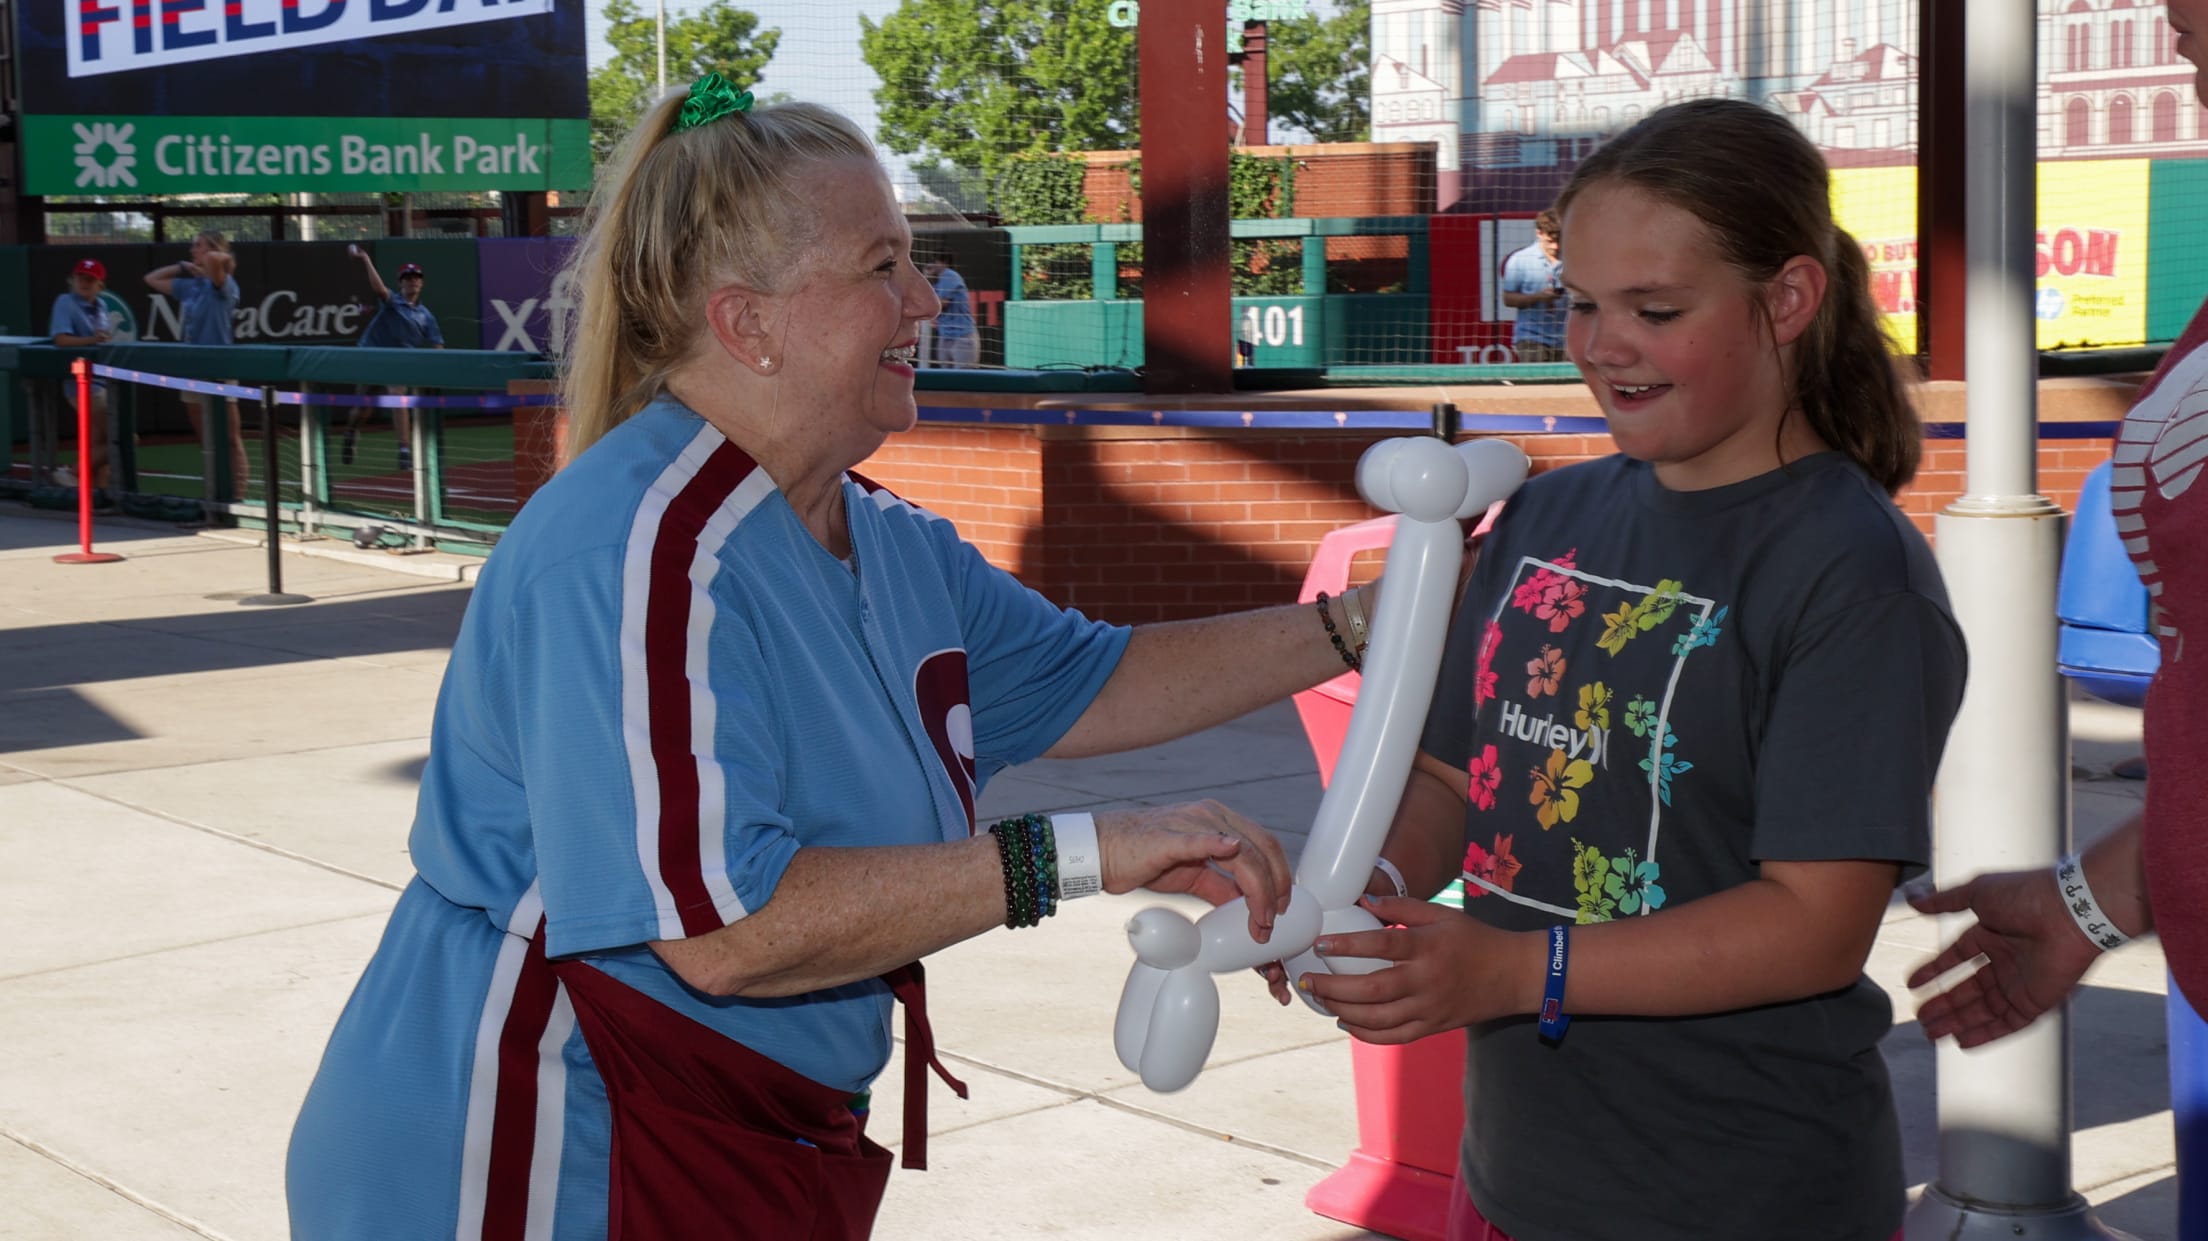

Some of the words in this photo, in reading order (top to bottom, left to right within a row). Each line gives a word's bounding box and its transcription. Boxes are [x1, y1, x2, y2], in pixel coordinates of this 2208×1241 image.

[154, 135, 332, 175] Citizens
[341, 133, 445, 174] Bank
[454, 133, 542, 174] Park
[1499, 700, 1589, 759] Hurley
